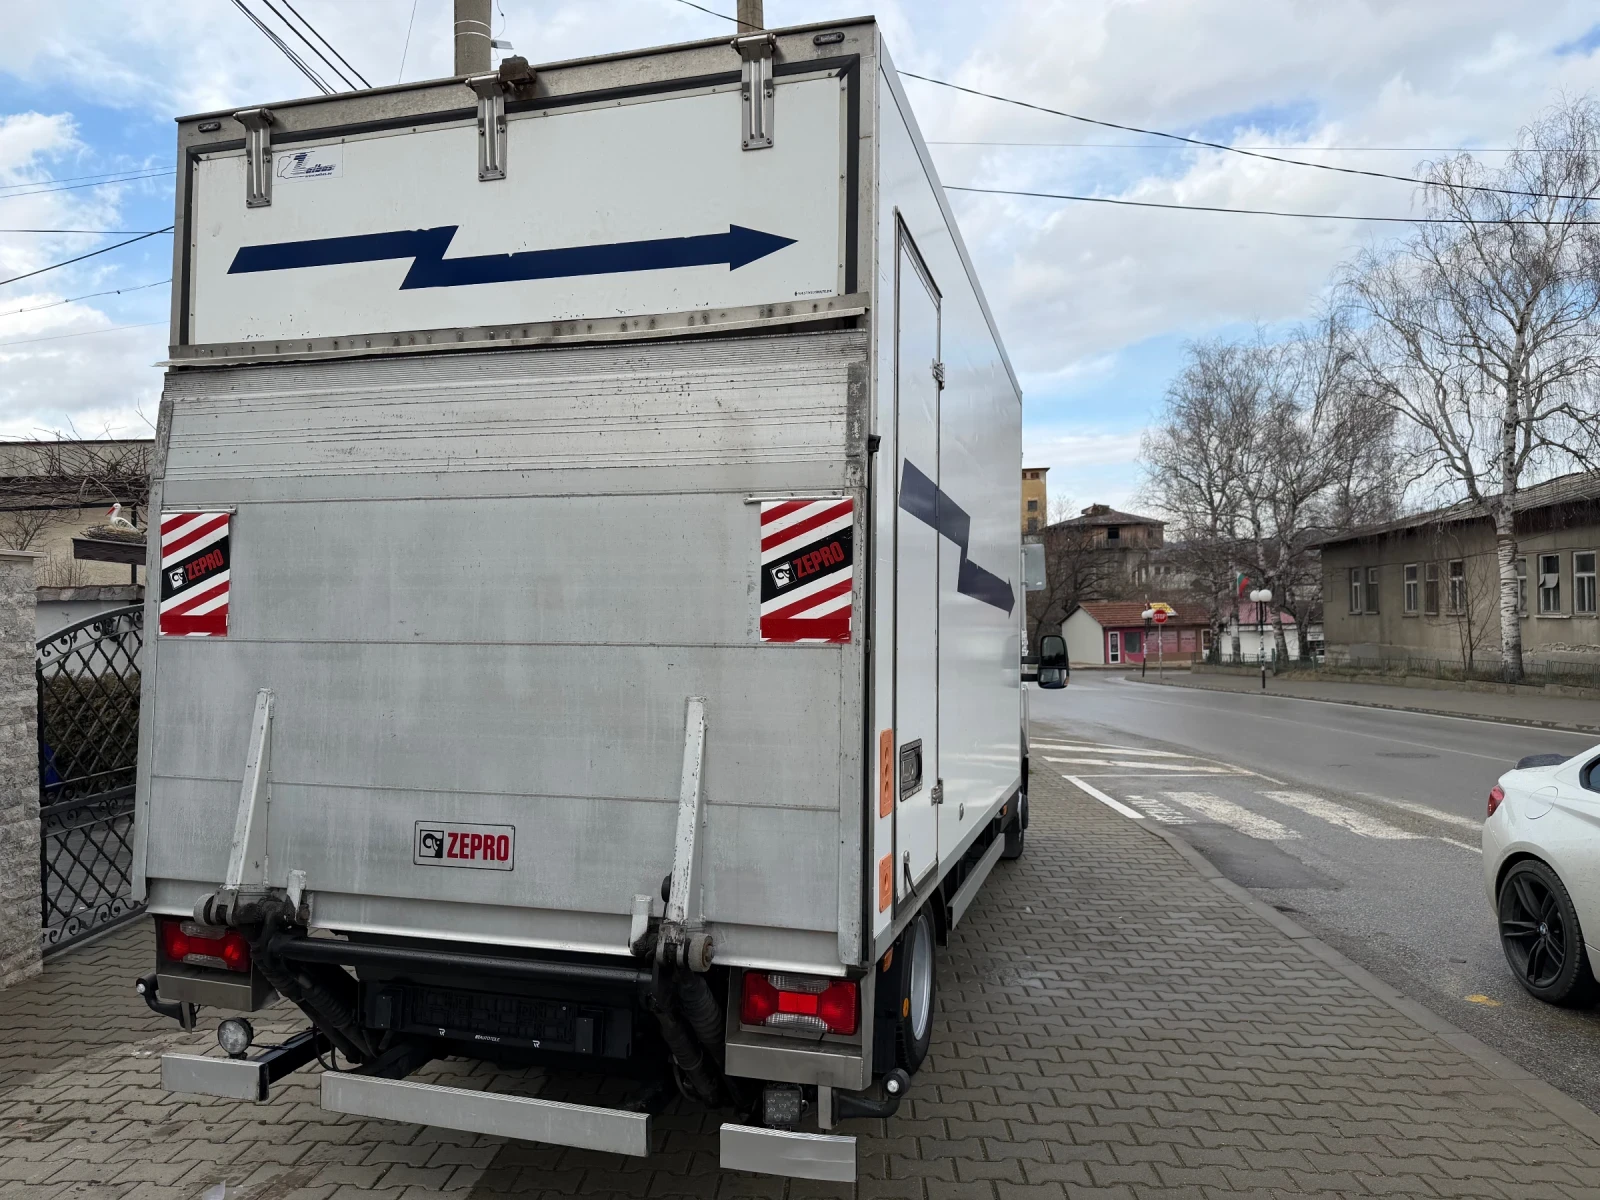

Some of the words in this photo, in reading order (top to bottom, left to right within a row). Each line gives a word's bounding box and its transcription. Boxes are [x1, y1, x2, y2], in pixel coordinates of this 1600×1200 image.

[185, 548, 224, 581] ZEPRO
[793, 541, 845, 578] ZEPRO
[446, 832, 510, 862] ZEPRO
